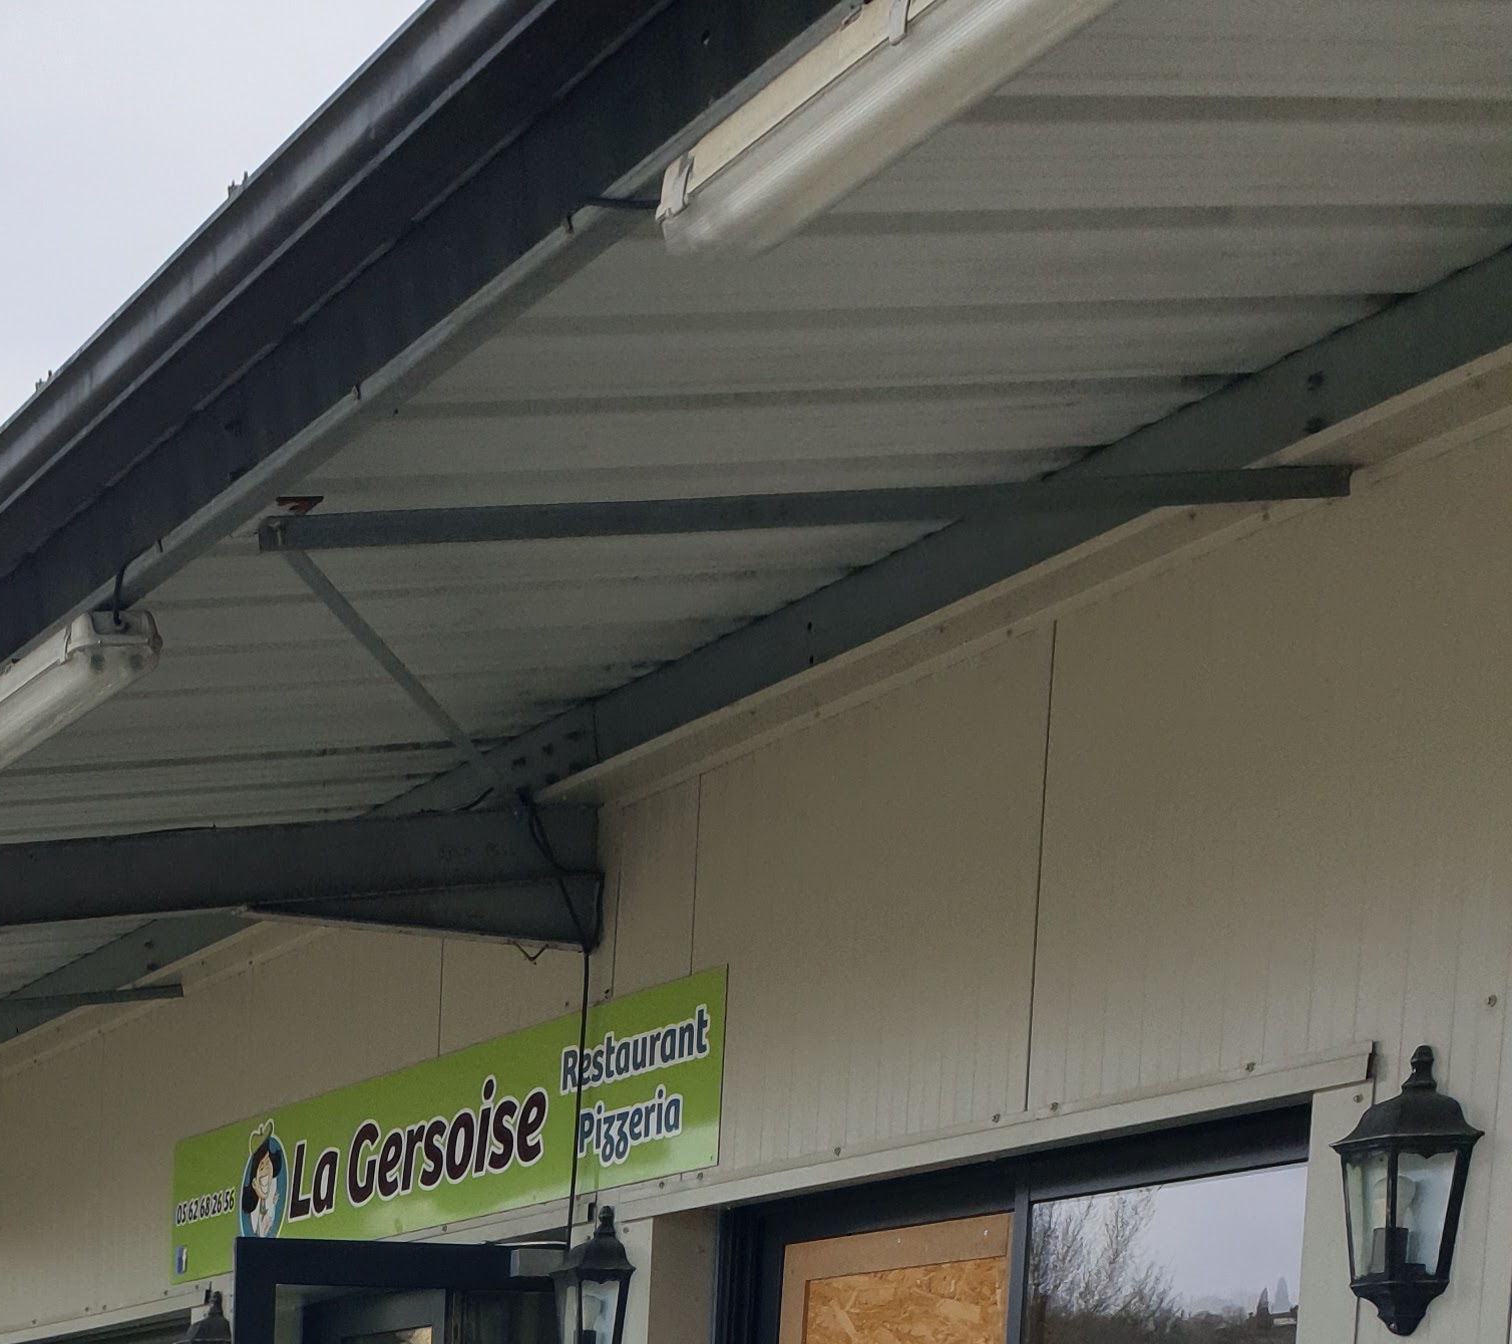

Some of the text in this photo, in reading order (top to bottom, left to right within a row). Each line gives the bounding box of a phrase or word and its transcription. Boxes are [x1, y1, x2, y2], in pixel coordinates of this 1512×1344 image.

[561, 1006, 709, 1092] Restaurant
[289, 1077, 547, 1220] La Gersoise
[579, 1087, 682, 1164] Pizzeria
